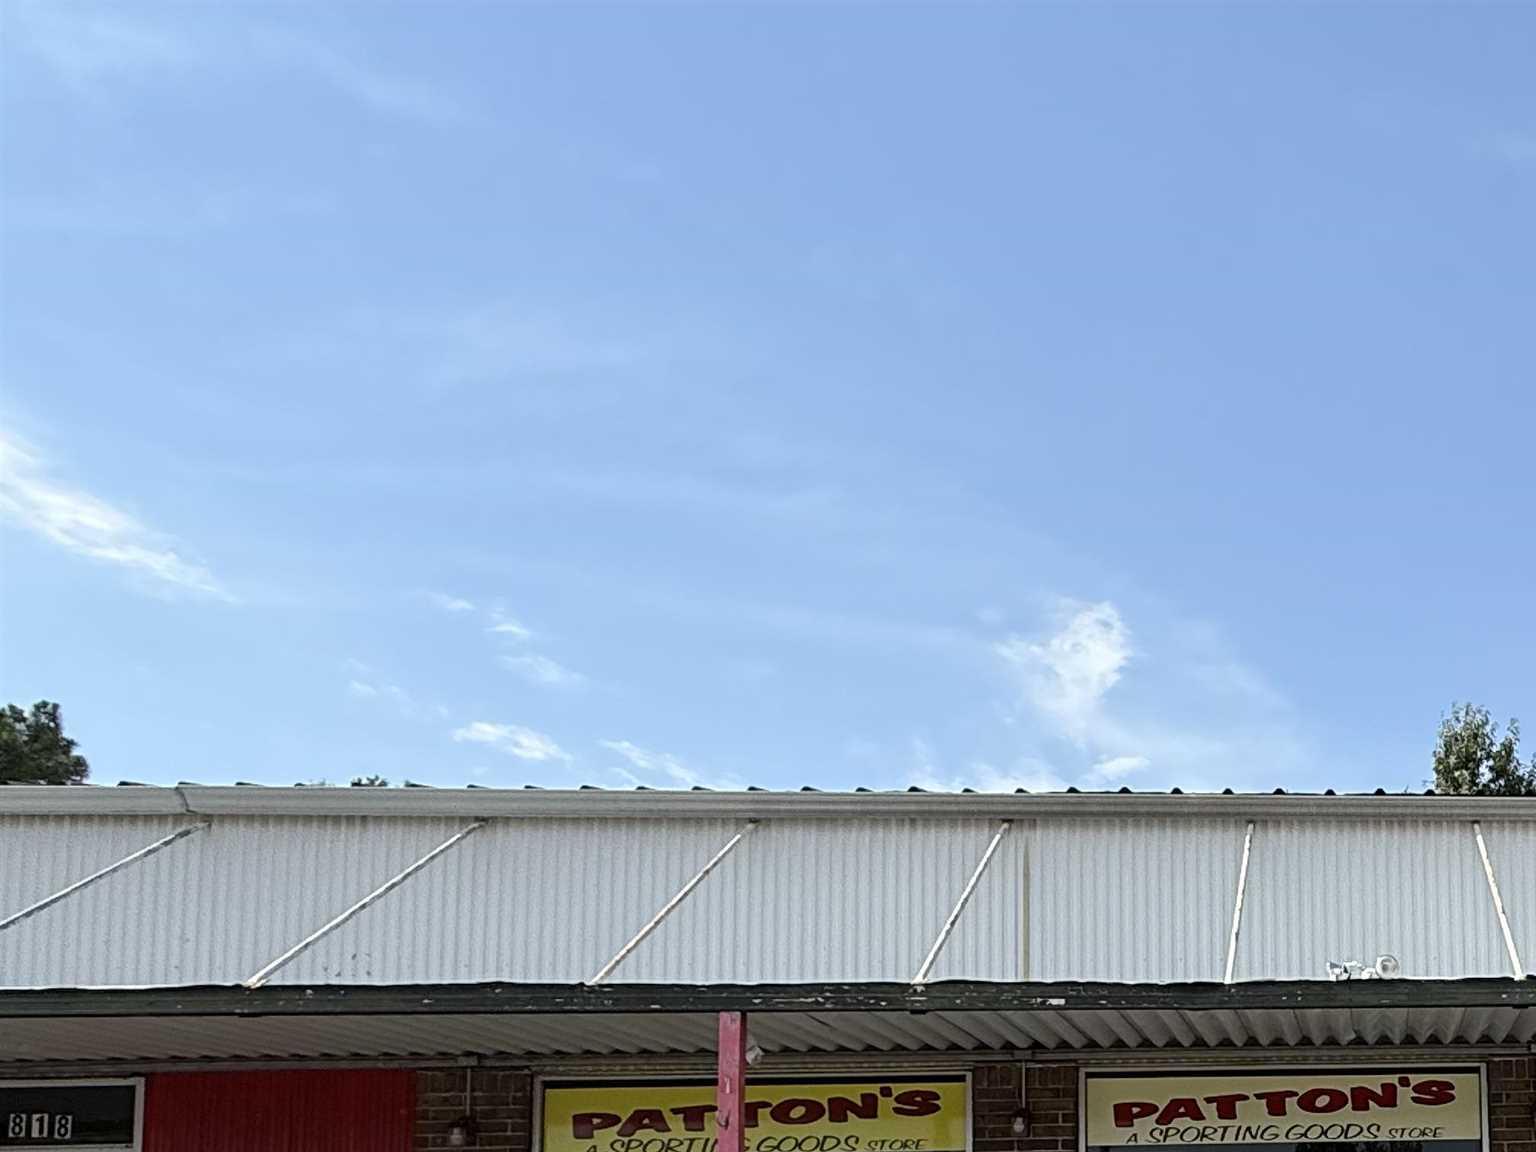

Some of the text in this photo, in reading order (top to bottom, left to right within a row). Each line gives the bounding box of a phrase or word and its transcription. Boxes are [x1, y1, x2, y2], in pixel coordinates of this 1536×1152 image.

[571, 1086, 942, 1140] PATTON'S
[1112, 1076, 1457, 1128] PATTON'S
[9, 1114, 71, 1138] 818
[1125, 1122, 1445, 1145] A SPORTING GOODS STORE
[755, 1135, 860, 1152] GOODS
[867, 1138, 928, 1152] STORE
